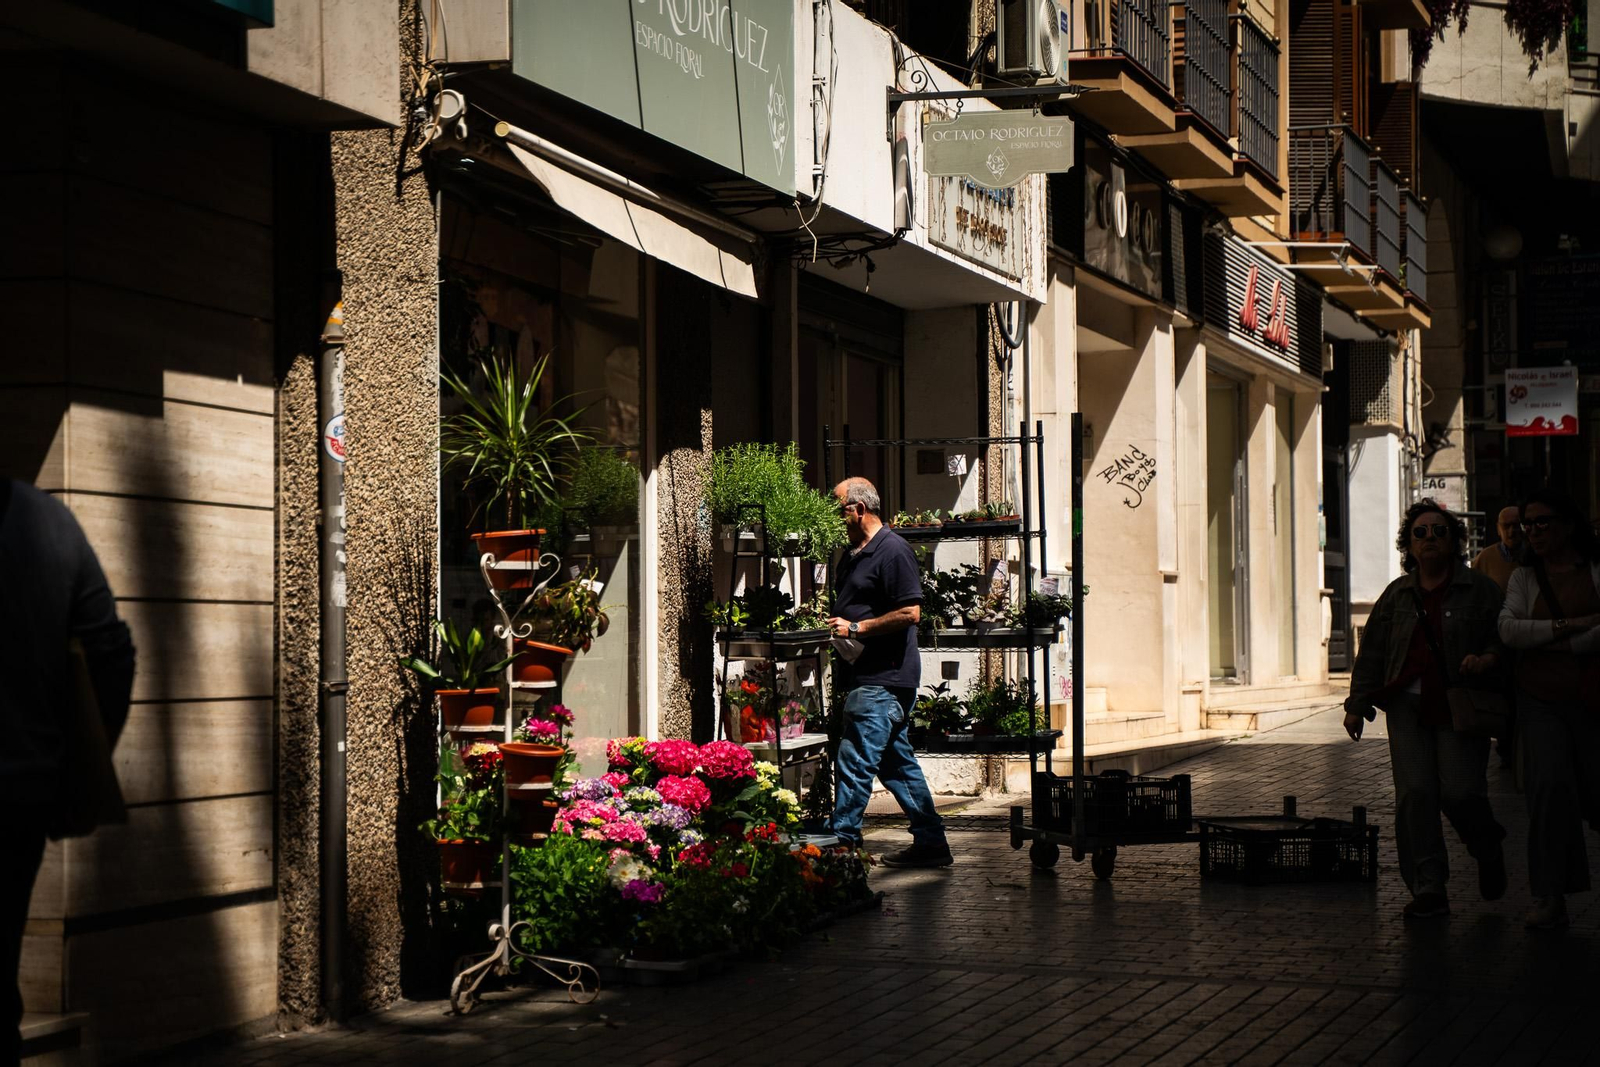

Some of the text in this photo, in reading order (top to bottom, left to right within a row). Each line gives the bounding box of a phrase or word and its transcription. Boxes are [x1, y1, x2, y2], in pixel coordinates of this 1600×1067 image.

[636, 20, 705, 79] ESPACIO FLORAL
[932, 126, 1064, 142] OCTAVIO RODRIGUEZ
[1010, 141, 1039, 149] ESPACIO
[1508, 371, 1538, 381] Nicolás
[1549, 370, 1573, 379] Israel
